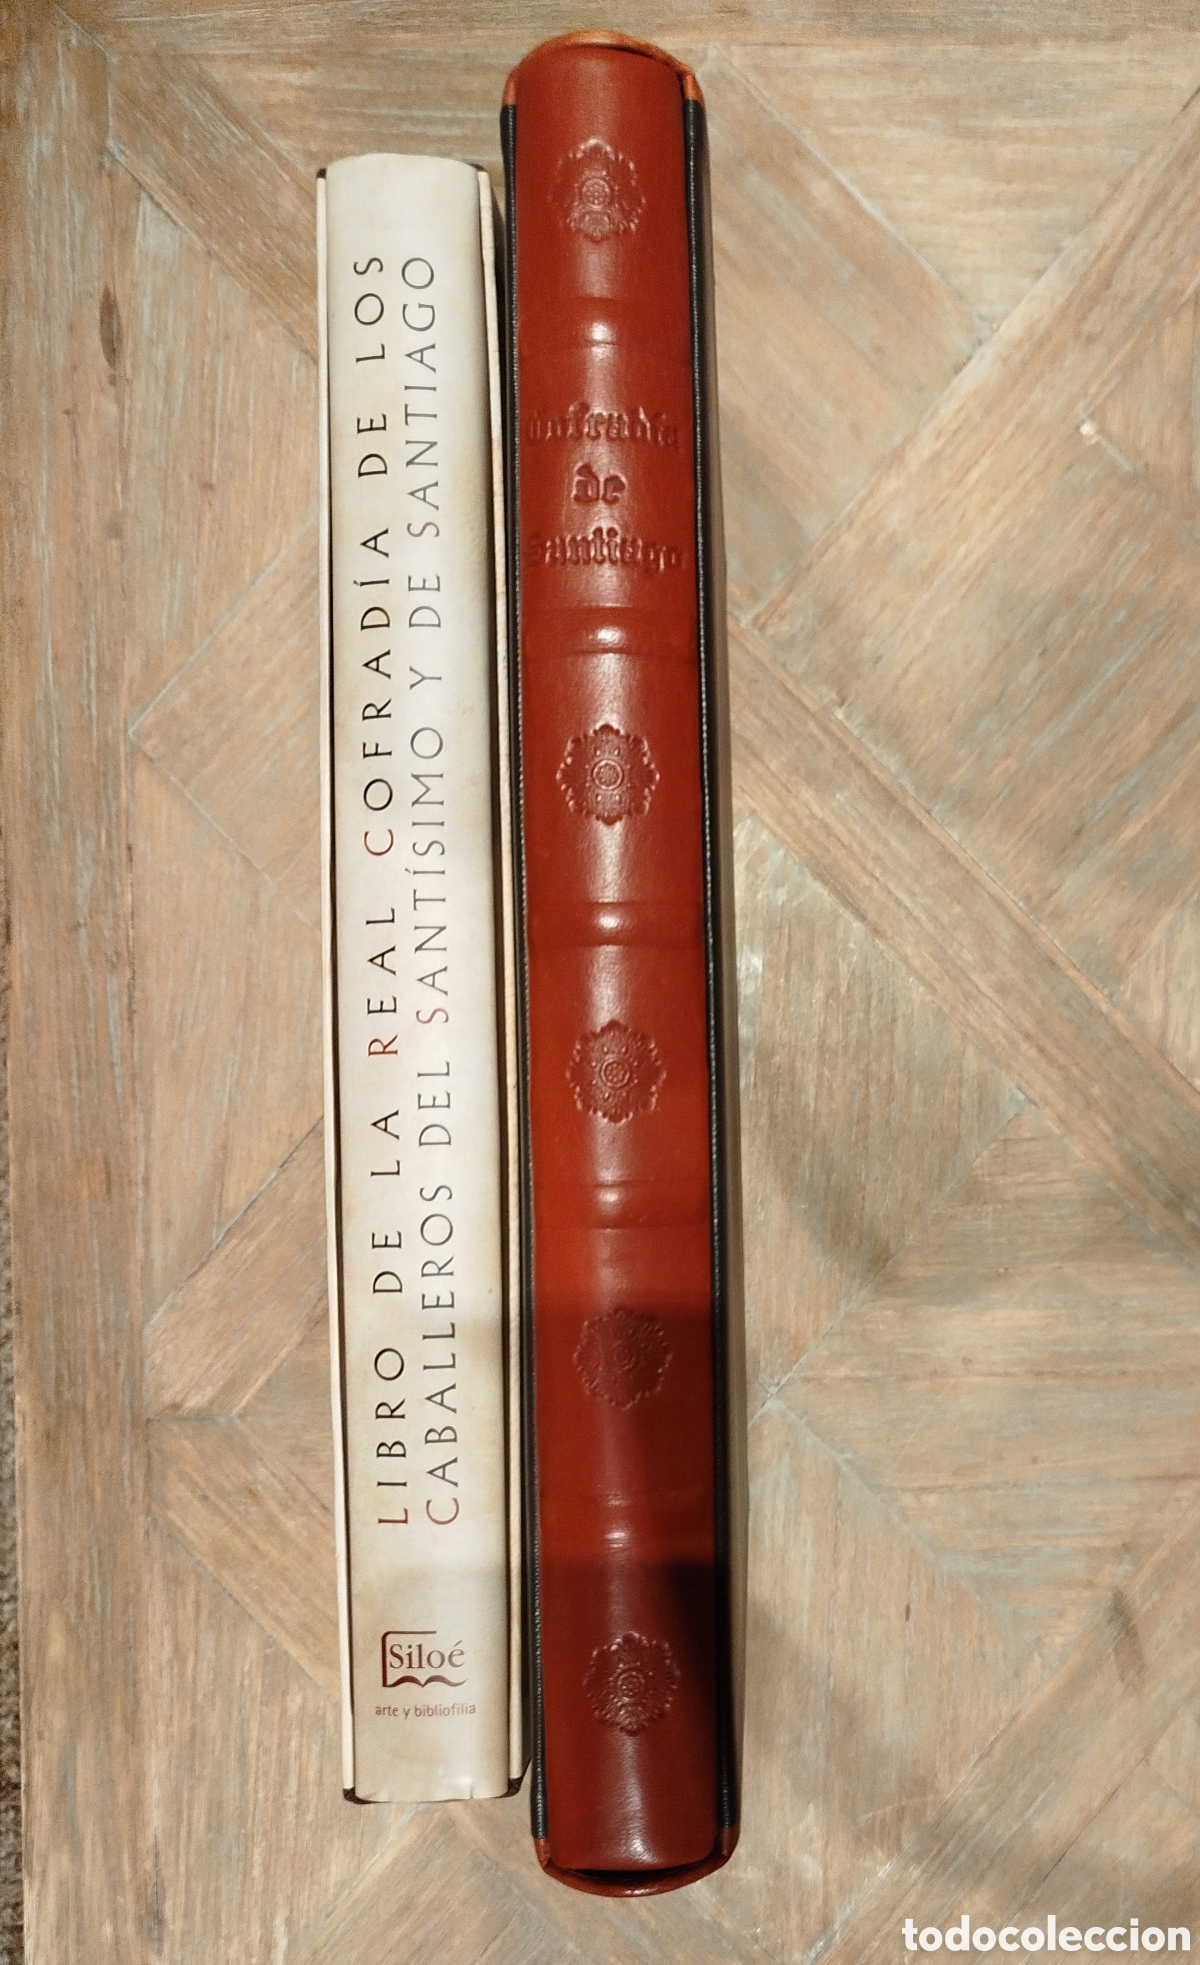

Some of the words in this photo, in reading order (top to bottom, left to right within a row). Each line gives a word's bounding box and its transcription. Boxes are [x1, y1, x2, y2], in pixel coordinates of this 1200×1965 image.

[352, 256, 386, 364] LOS
[400, 256, 441, 538] SANTIAGO
[356, 412, 389, 479] DE
[571, 463, 628, 504] de
[407, 574, 442, 629] DE
[352, 527, 395, 857] COFRADÍA
[408, 665, 443, 691] Y
[403, 726, 450, 1025] SANTÍSIMO
[365, 906, 399, 1058] REAL
[369, 1108, 401, 1178] LA
[416, 1060, 452, 1148] DEL
[371, 1230, 404, 1295] DE
[418, 1184, 460, 1526] CABALLEROS
[373, 1346, 409, 1525] LIBRO
[389, 1640, 465, 1669] Siloé
[375, 1704, 399, 1716] arte
[402, 1707, 411, 1720] y
[414, 1703, 476, 1718] bibliofilia
